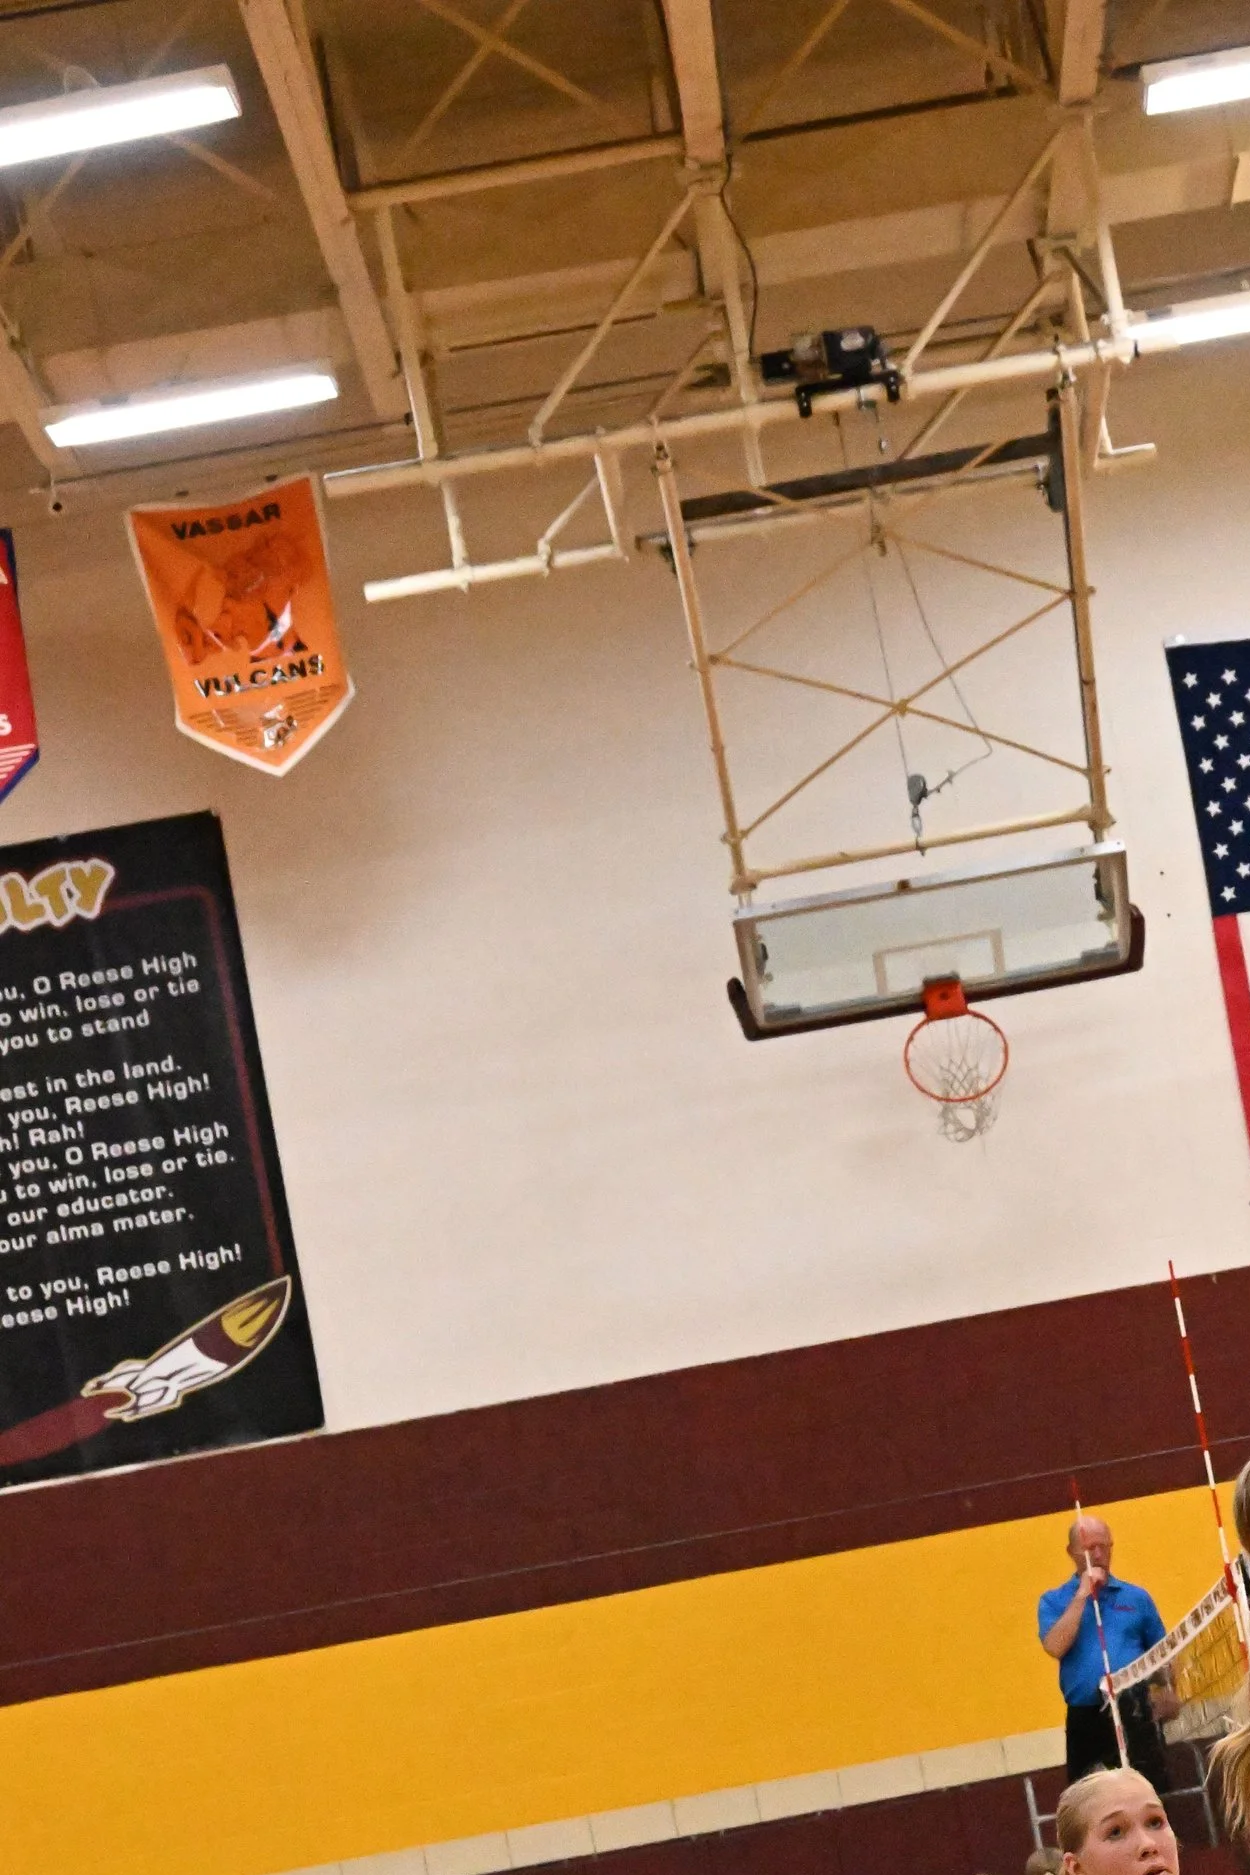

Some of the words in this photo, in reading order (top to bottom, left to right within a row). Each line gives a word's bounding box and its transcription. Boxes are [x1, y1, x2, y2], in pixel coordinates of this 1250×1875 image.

[171, 502, 281, 541] VASSAR
[194, 654, 326, 699] VULCANS
[0, 857, 115, 931] LTY
[33, 976, 51, 995] O
[59, 965, 134, 991] Reese
[142, 952, 198, 976] High
[19, 1002, 69, 1024] win,
[75, 992, 126, 1013] lose
[134, 986, 160, 1002] or
[168, 976, 200, 997] tie
[47, 1026, 73, 1043] to
[81, 1009, 151, 1038] stand
[0, 1081, 39, 1102] est
[46, 1077, 68, 1094] in
[75, 1068, 116, 1088] the
[123, 1055, 182, 1079] land.
[7, 1106, 58, 1129] you,
[65, 1090, 139, 1115] Reese
[147, 1073, 211, 1100] High!
[8, 1156, 58, 1179] you,
[65, 1146, 83, 1165] O
[91, 1136, 166, 1160] Reese
[173, 1121, 229, 1146] High
[28, 1121, 85, 1148] Rah!
[15, 1183, 41, 1200] to
[48, 1173, 97, 1194] win,
[104, 1163, 154, 1184] lose
[162, 1156, 188, 1174] or
[196, 1148, 235, 1168] tie.
[7, 1207, 49, 1227] our
[56, 1186, 174, 1218] educator.
[46, 1222, 105, 1245] alma
[113, 1207, 195, 1233] mater.
[6, 1285, 33, 1302] to
[40, 1276, 89, 1299] you,
[97, 1260, 172, 1286] Reese
[178, 1243, 242, 1271] High!
[1, 1304, 59, 1329] eese
[66, 1288, 130, 1316] High!
